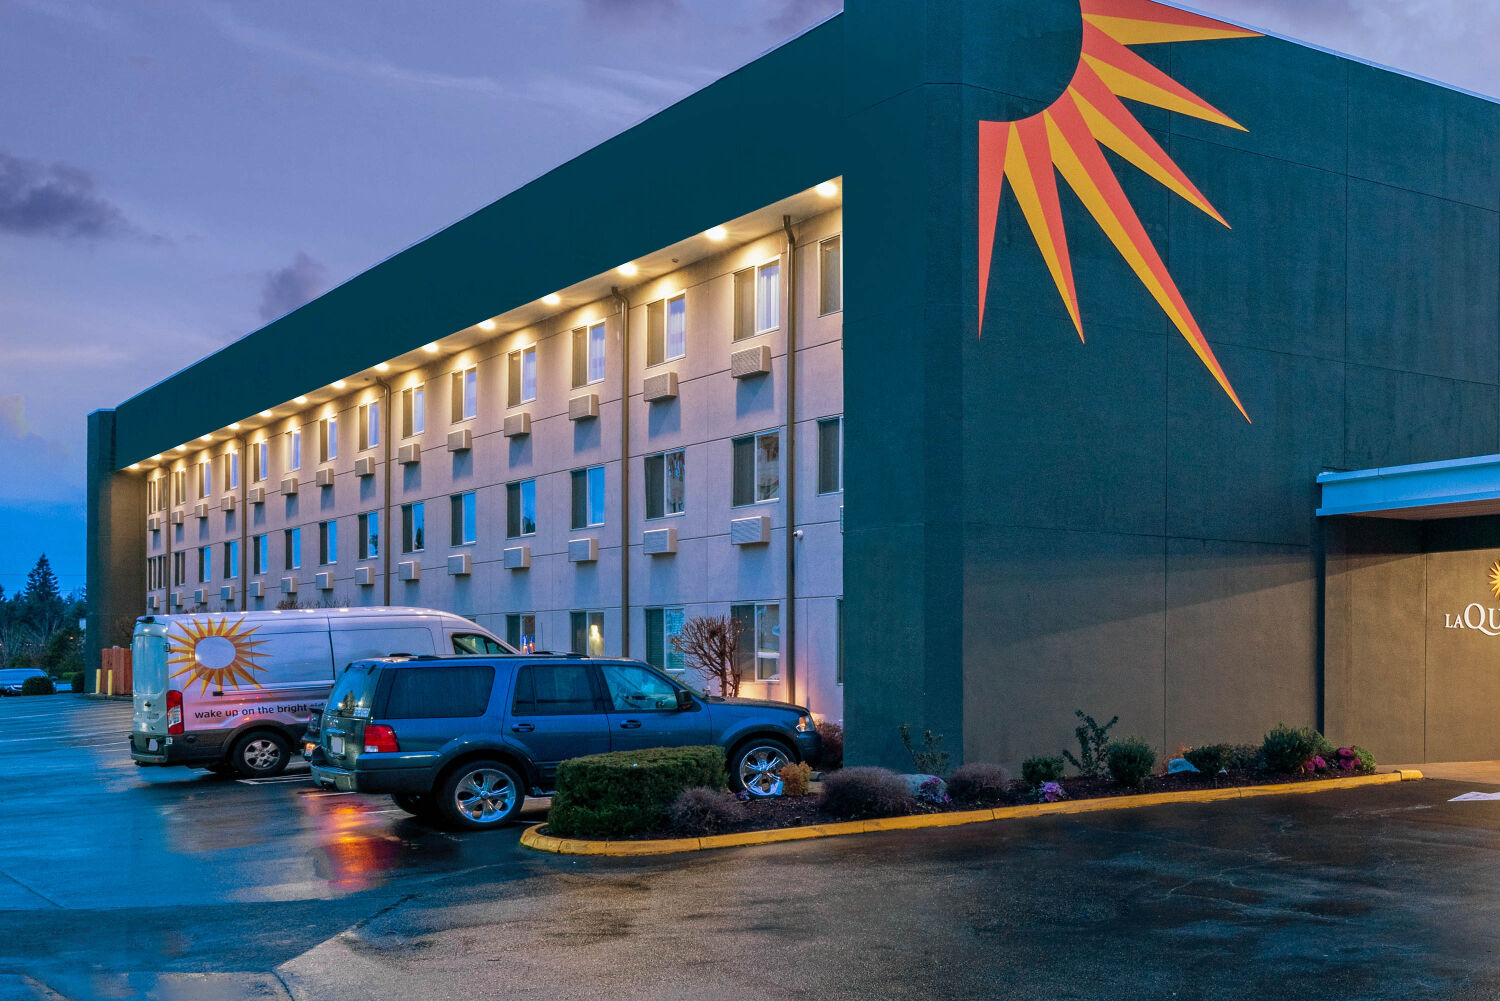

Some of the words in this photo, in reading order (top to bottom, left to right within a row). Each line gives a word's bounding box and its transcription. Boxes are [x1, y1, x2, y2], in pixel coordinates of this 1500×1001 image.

[195, 710, 222, 719] wake
[225, 709, 239, 717] up
[242, 708, 255, 716] on
[258, 706, 275, 714] the
[277, 703, 308, 713] bright
